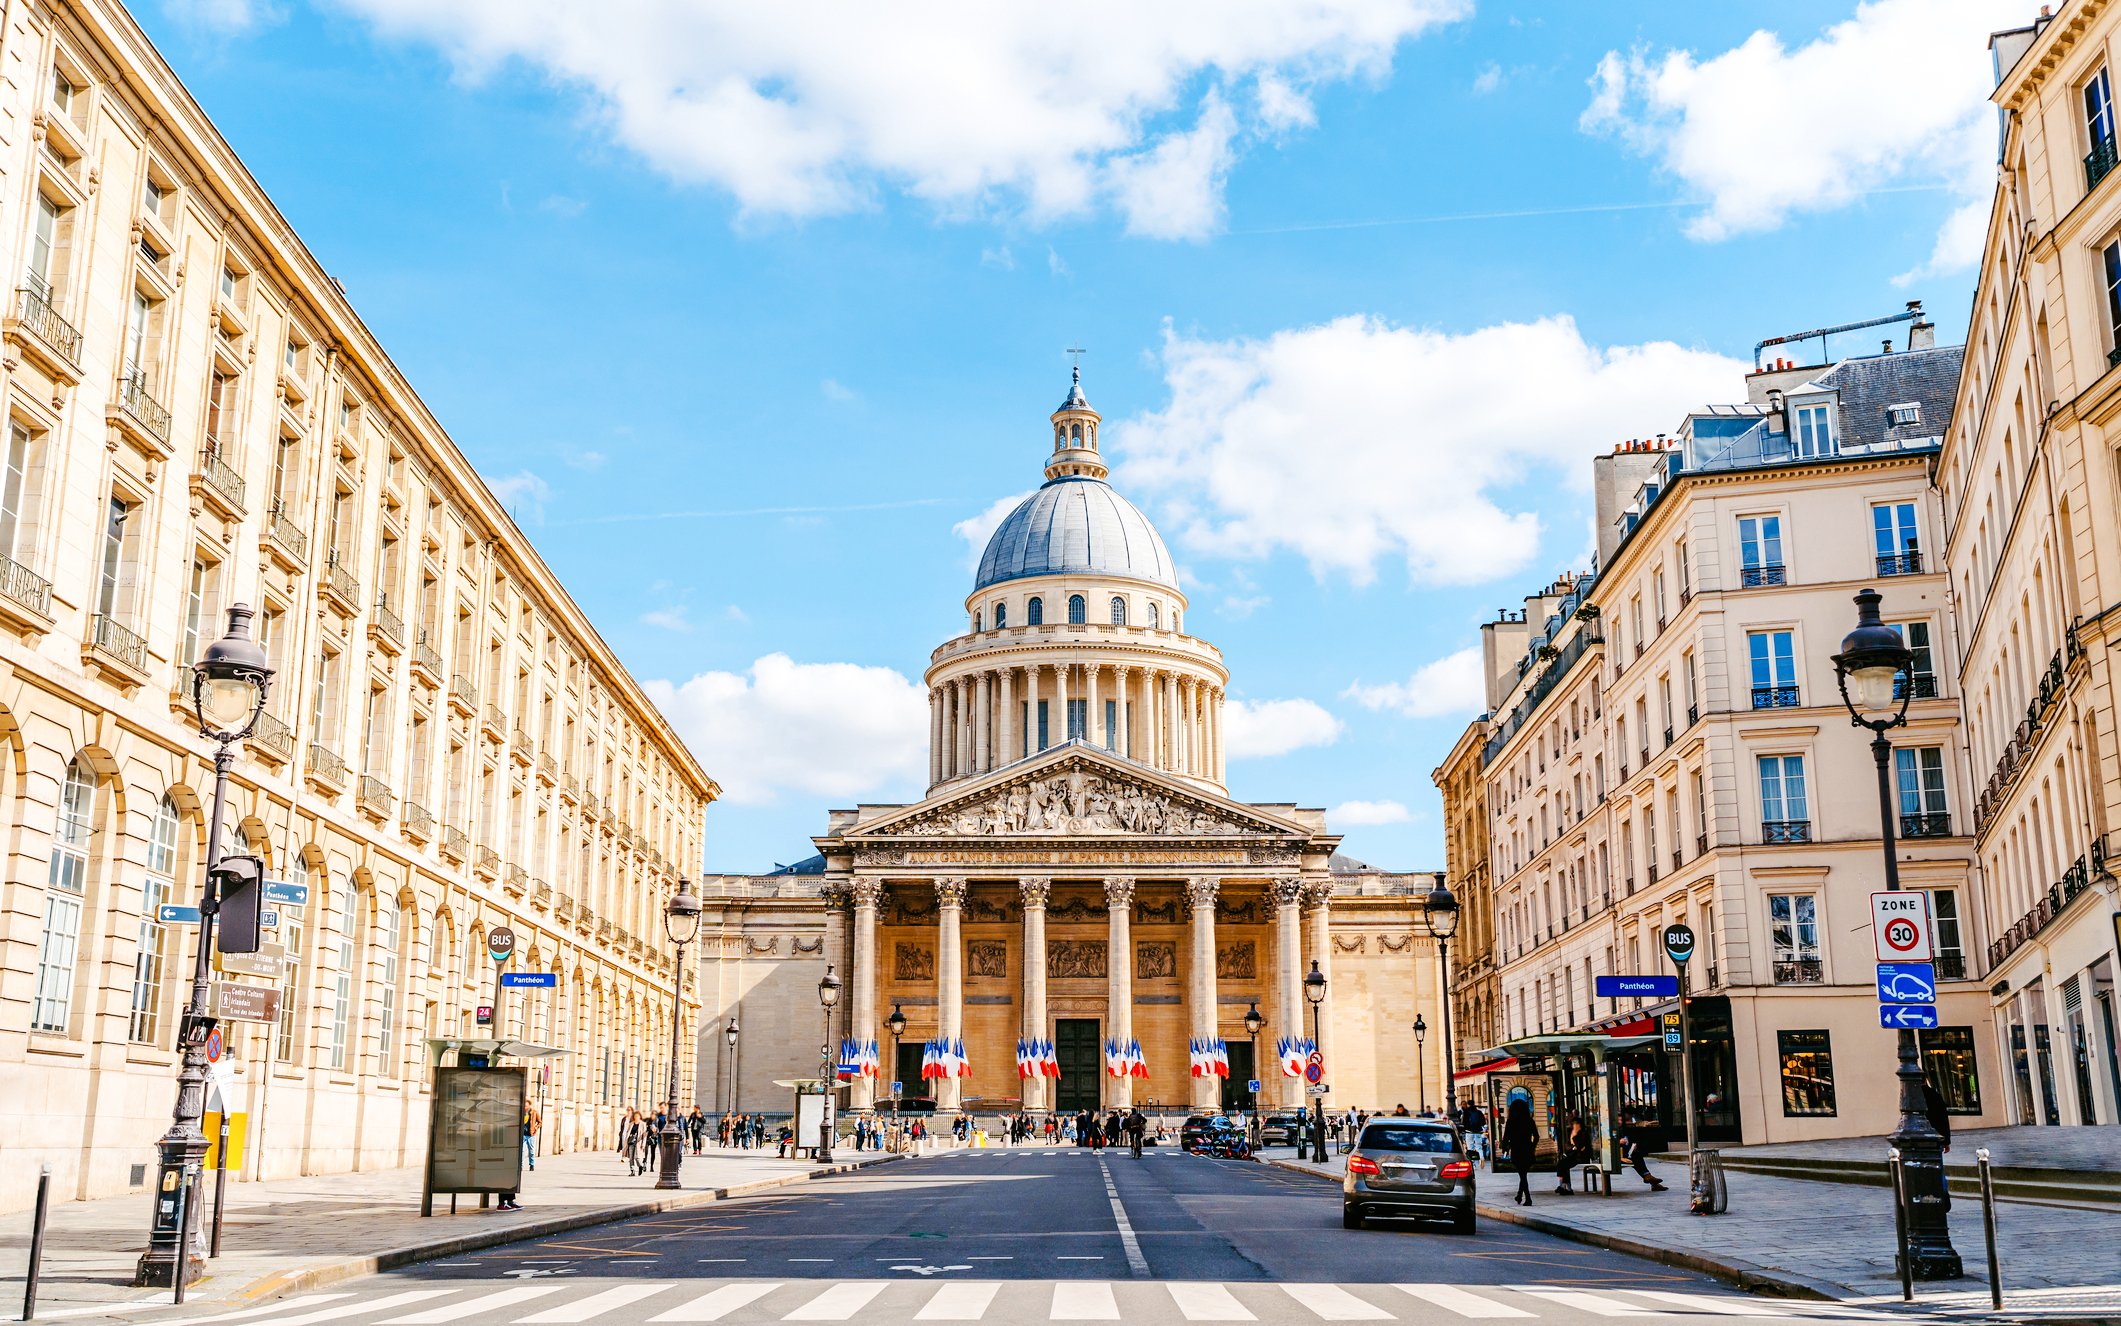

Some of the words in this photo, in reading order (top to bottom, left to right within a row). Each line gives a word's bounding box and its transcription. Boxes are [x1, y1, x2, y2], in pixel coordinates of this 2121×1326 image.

[909, 852, 939, 863] AUX
[939, 852, 993, 863] GRANDS
[995, 852, 1051, 863] HOMMES
[1059, 852, 1075, 863] LA
[1080, 852, 1125, 863] PATRIE
[1129, 852, 1243, 863] RECONNAISSANTE
[1882, 901, 1916, 910] ZONE
[1668, 933, 1690, 945] BUS
[1892, 928, 1912, 941] 30
[492, 935, 511, 945] BUS
[1619, 982, 1655, 990] Panthéon
[231, 987, 246, 996] Centre
[231, 997, 251, 1007] Irlandais
[479, 1008, 490, 1016] 24
[1666, 1015, 1677, 1023] 75
[1667, 1034, 1679, 1043] 89
